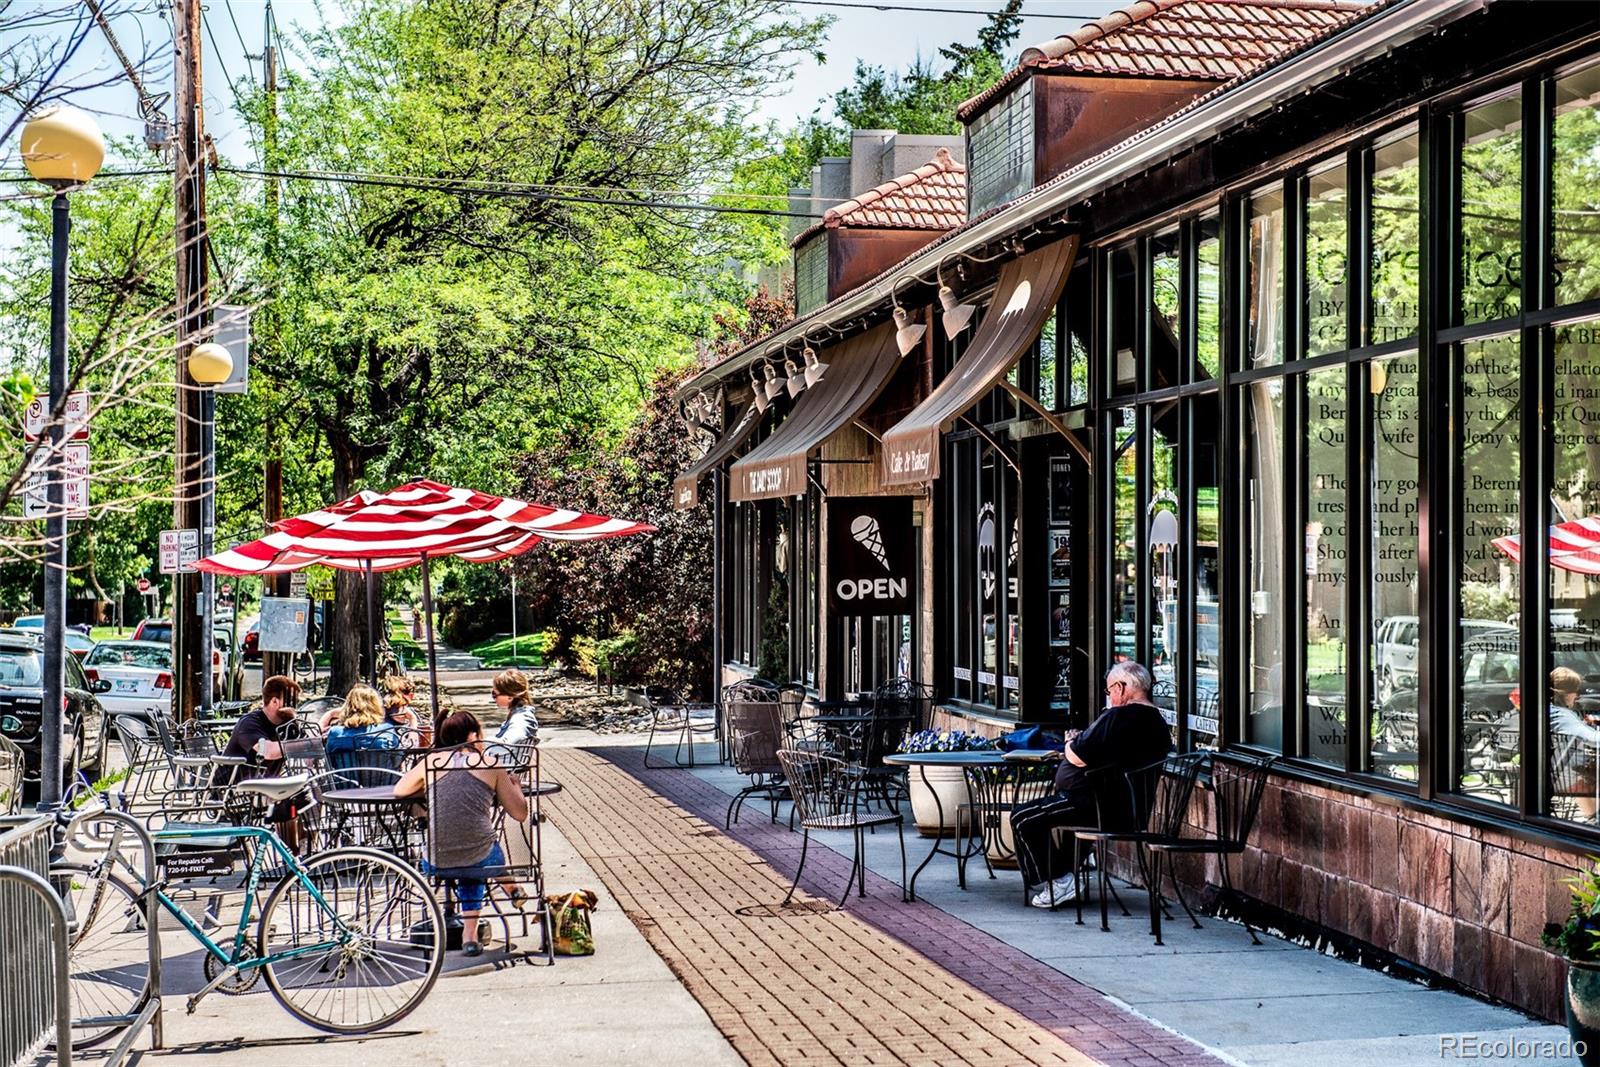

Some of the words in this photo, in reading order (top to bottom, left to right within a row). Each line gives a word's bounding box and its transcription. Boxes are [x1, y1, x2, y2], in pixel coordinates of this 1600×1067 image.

[1319, 301, 1344, 317] BY
[1486, 358, 1510, 375] the
[1382, 427, 1415, 444] wife
[911, 448, 930, 475] Bakery
[165, 534, 174, 543] NO
[161, 543, 178, 552] PARKING
[1378, 543, 1414, 560] after
[836, 577, 907, 600] OPEN
[178, 858, 200, 866] Repairs
